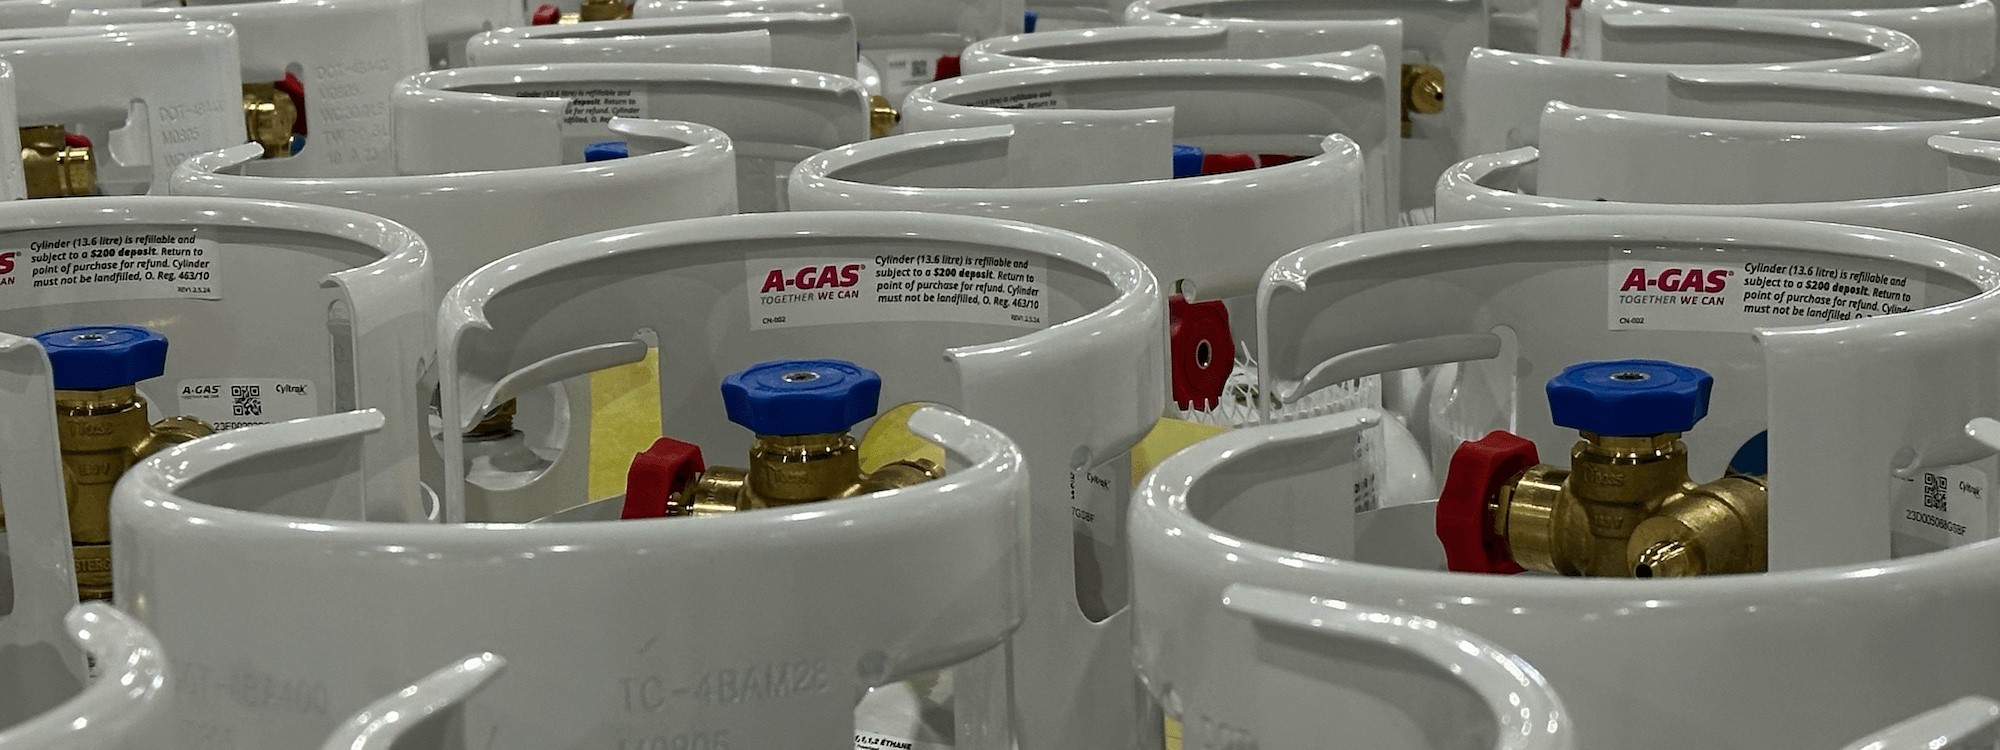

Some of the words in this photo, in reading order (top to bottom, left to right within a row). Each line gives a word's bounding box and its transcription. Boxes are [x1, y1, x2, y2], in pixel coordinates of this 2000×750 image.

[31, 240, 70, 252] Cylinder
[73, 237, 97, 248] (13.6
[99, 236, 123, 246] litre)
[125, 235, 133, 244] is
[135, 234, 176, 246] refillable
[177, 235, 196, 244] and
[31, 252, 67, 264] subject
[69, 251, 79, 260] to
[90, 248, 115, 258] $200
[161, 247, 191, 256] Return
[193, 248, 203, 256] to
[875, 255, 915, 267] Cylinder
[917, 255, 940, 265] (13.6
[942, 255, 963, 267] litre)
[965, 256, 972, 265] is
[974, 256, 1012, 268] refillable
[1013, 259, 1029, 269] and
[32, 265, 58, 277] point
[60, 263, 72, 274] of
[73, 261, 118, 273] purchase
[119, 260, 135, 271] for
[137, 258, 170, 270] refund.
[173, 259, 210, 270] Cylinder
[875, 268, 911, 280] subject
[913, 268, 923, 277] to
[925, 269, 931, 277] a
[933, 268, 957, 277] $200
[959, 268, 995, 281] deposit.
[997, 270, 1024, 282] Return
[1026, 274, 1035, 283] to
[1744, 262, 1787, 275] Cylinder
[1788, 265, 1814, 277] (13.6
[1815, 267, 1838, 280] litre)
[1840, 269, 1848, 280] is
[1849, 271, 1889, 285] refillable
[1889, 277, 1907, 287] and
[33, 278, 59, 288] must
[60, 276, 78, 285] not
[79, 275, 92, 283] be
[94, 271, 142, 283] landfilled,
[145, 271, 155, 280] O.
[157, 271, 176, 282] Reg.
[178, 271, 210, 280] 463/10
[876, 280, 903, 293] point
[904, 280, 915, 292] of
[917, 280, 959, 292] purchase
[960, 281, 974, 293] for
[975, 282, 1005, 295] refund.
[1007, 284, 1039, 297] Cylinder
[1743, 276, 1781, 289] subject
[1783, 279, 1794, 288] to
[1796, 281, 1803, 289] a
[1805, 280, 1830, 291] $200
[1832, 282, 1870, 296] deposit.
[1872, 287, 1901, 301] Return
[1902, 292, 1911, 302] to
[760, 293, 814, 305] TOGETHER
[817, 291, 834, 301] WE
[837, 290, 860, 299] CAN
[877, 294, 902, 303] must
[904, 294, 921, 302] not
[923, 292, 935, 302] be
[936, 293, 980, 306] landfilled,
[982, 296, 991, 305] O.
[993, 296, 1010, 309] Reg.
[1012, 298, 1039, 309] 463/10
[1619, 295, 1677, 305] TOGETHER
[1680, 296, 1698, 305] WE
[1701, 296, 1725, 306] CAN
[1743, 290, 1772, 302] point
[1773, 291, 1786, 303] of
[1786, 293, 1831, 305] purchase
[1832, 296, 1847, 308] for
[1848, 299, 1879, 311] refund.
[1743, 305, 1771, 314] must
[1772, 306, 1791, 315] not
[1792, 305, 1805, 316] be
